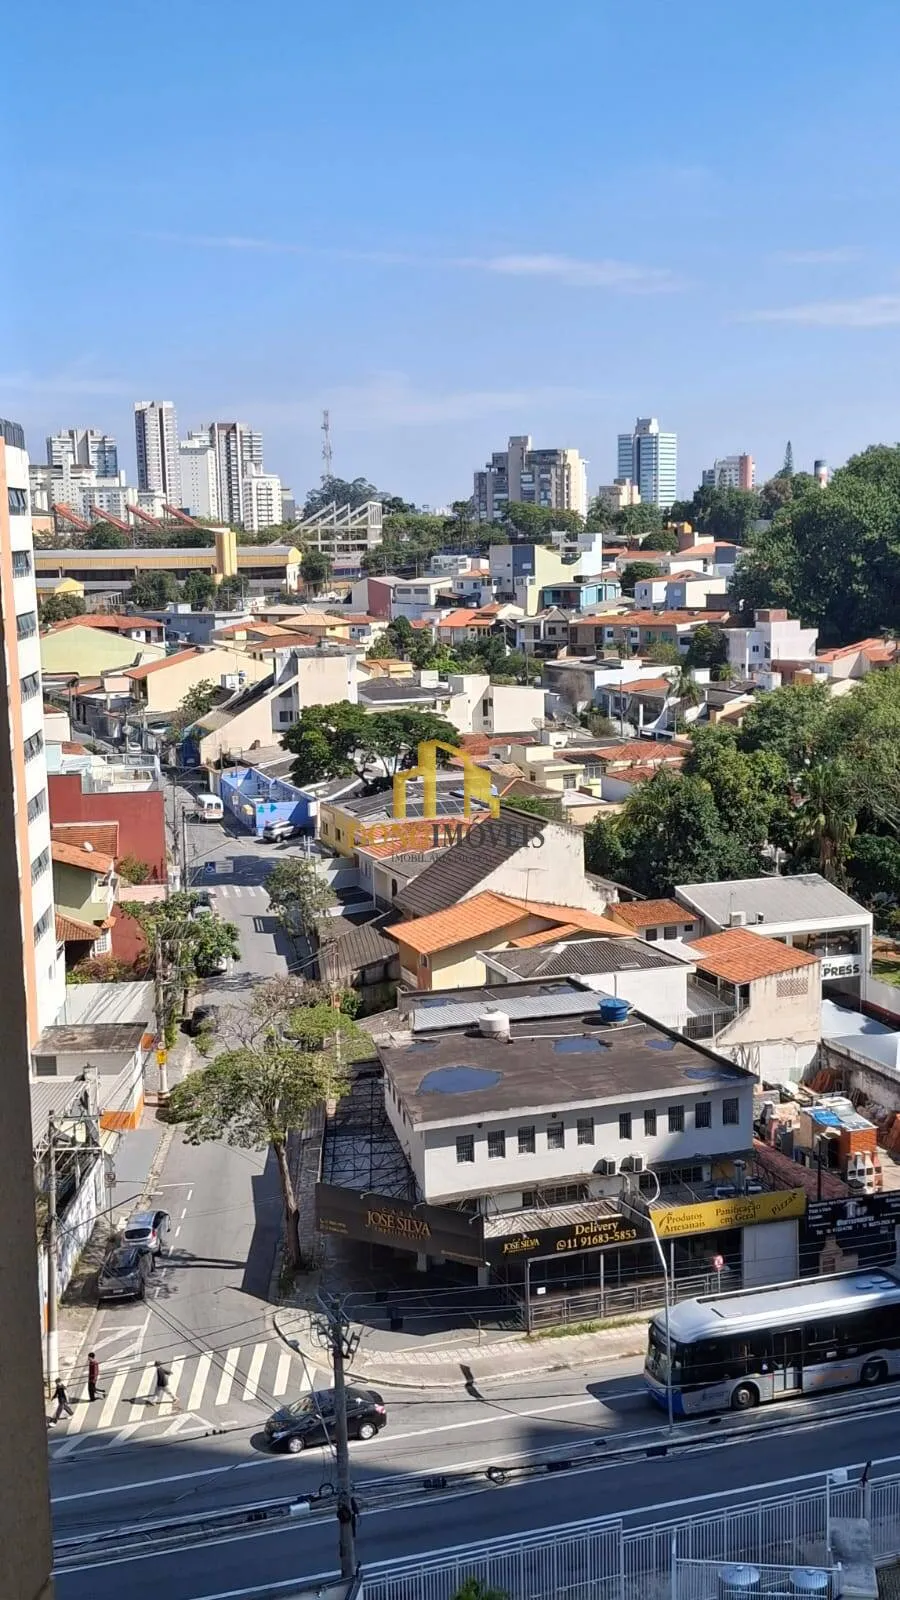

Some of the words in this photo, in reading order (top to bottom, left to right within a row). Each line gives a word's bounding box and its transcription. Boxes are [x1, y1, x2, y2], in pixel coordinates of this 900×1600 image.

[666, 1213, 703, 1224] Produtos
[720, 1217, 733, 1226] em
[397, 1217, 432, 1237] SILVA
[575, 1221, 619, 1235] Delivery
[664, 1220, 706, 1234] Artesanais
[520, 1238, 541, 1249] SILVA
[580, 1229, 637, 1246] 91683-5853
